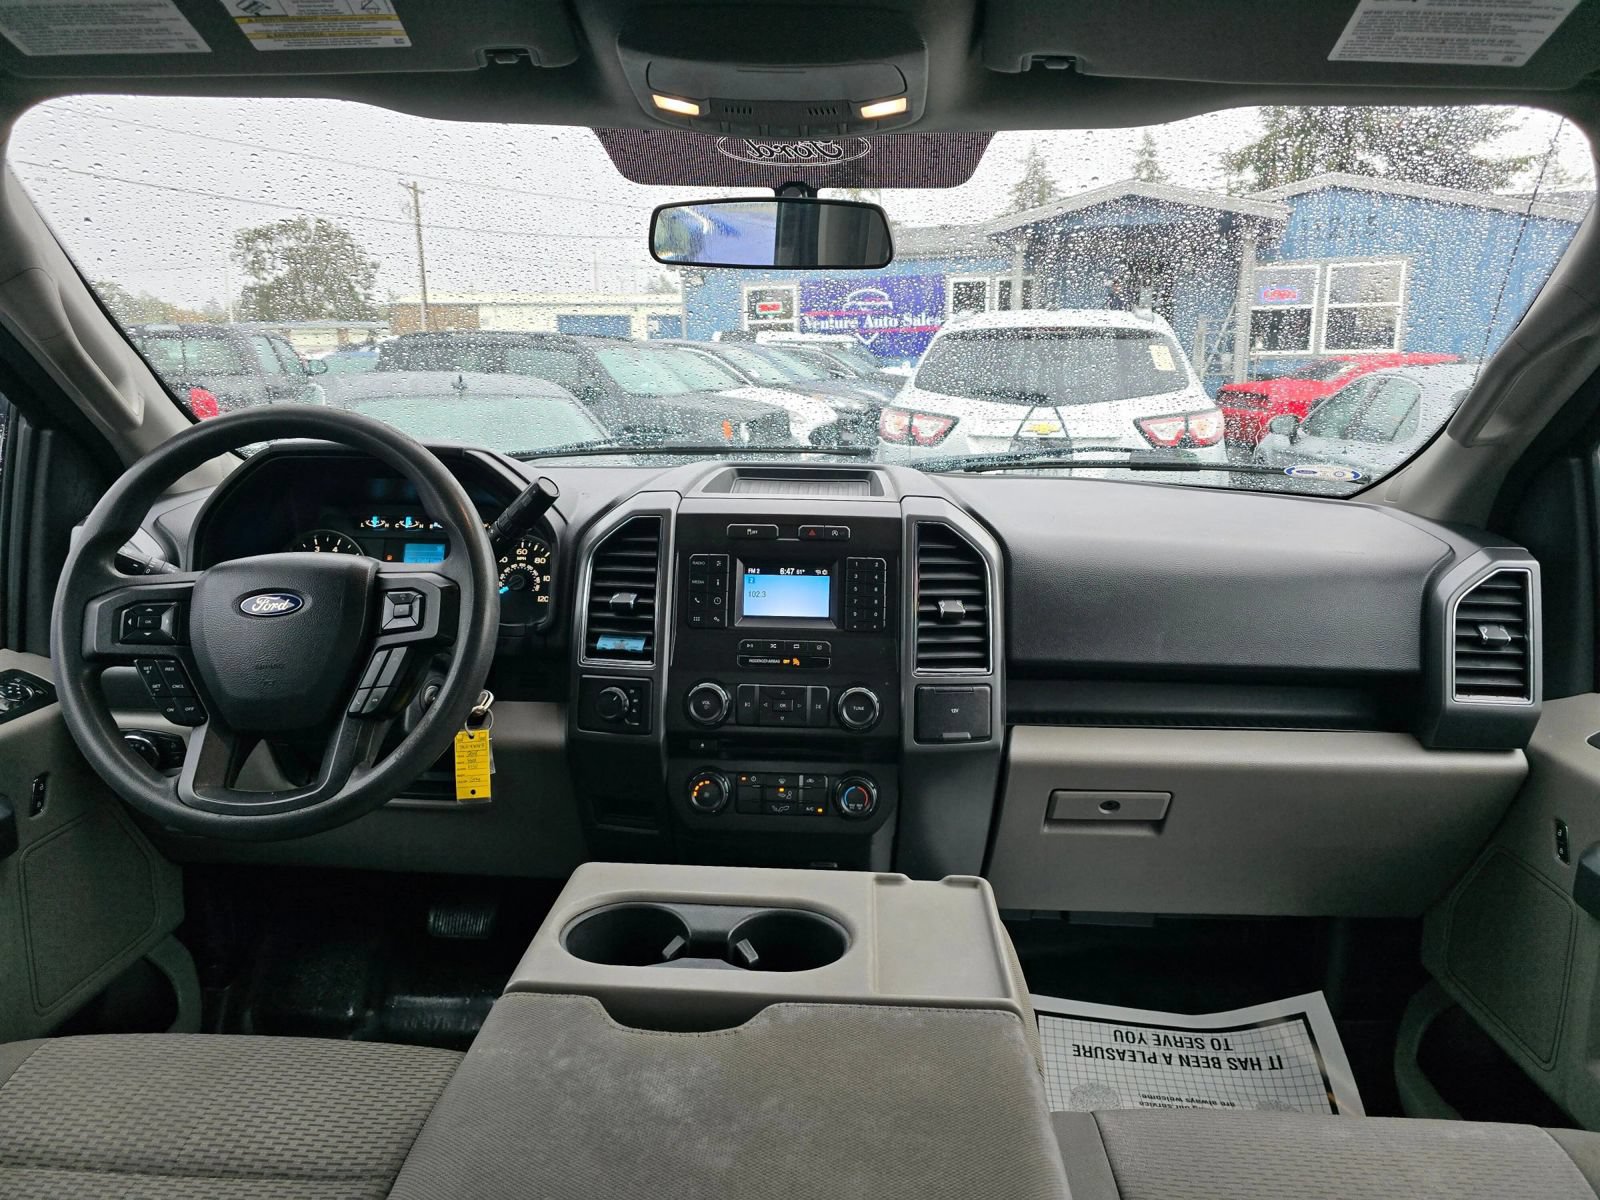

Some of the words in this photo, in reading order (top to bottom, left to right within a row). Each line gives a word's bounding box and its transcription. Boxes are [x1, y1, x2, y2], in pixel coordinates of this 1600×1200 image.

[803, 315, 859, 330] Venture
[864, 314, 898, 328] Auto
[902, 312, 943, 326] Sales
[748, 590, 767, 598] 102.3
[251, 596, 290, 612] Ford
[1113, 1029, 1148, 1045] YOU
[1151, 1033, 1205, 1048] SERVE
[1209, 1038, 1233, 1052] TO
[1071, 1043, 1157, 1065] PLEASURE
[1161, 1052, 1173, 1066] A
[1179, 1054, 1221, 1069] BEEN
[1226, 1056, 1261, 1071] HAS
[1267, 1054, 1284, 1071] IT
[1185, 1097, 1217, 1107] always
